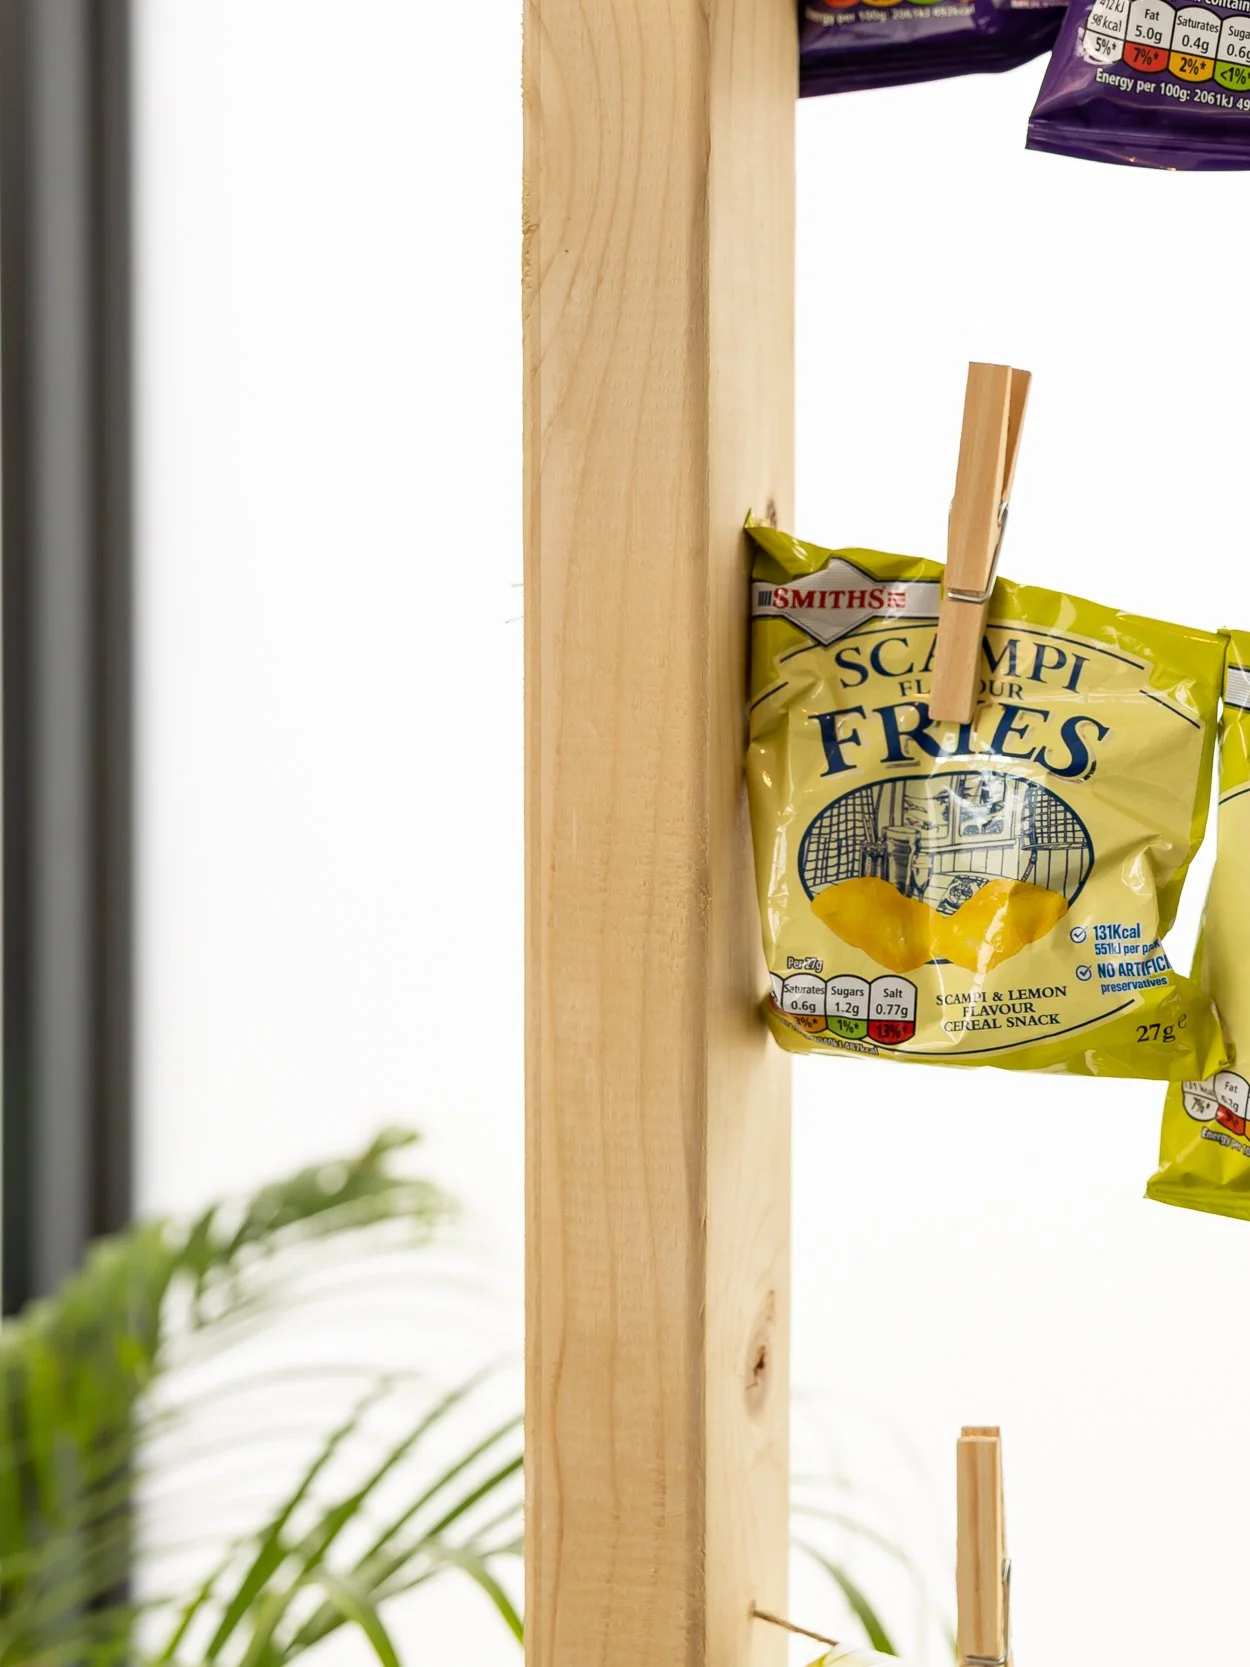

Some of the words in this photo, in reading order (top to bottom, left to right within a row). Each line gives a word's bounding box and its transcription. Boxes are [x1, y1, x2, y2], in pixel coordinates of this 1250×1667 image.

[1103, 14, 1122, 32] kcal
[1144, 8, 1160, 22] Fat
[1177, 15, 1219, 34] Saturates
[1134, 26, 1163, 44] 5.0g
[1181, 34, 1209, 53] 0.4g
[1096, 67, 1134, 92] Energy
[1136, 78, 1156, 94] per
[1160, 83, 1191, 102] 100g:
[1193, 90, 1234, 109] 2061kJ
[772, 587, 884, 611] SMITHS
[808, 700, 1111, 780] FRIES
[1093, 923, 1140, 940] 131Kcal
[1095, 942, 1121, 955] 551kJ
[1123, 944, 1140, 956] per
[787, 957, 802, 970] Per
[802, 957, 824, 973] 27g
[1097, 963, 1115, 978] NO
[783, 984, 825, 995] Saturates
[831, 986, 864, 998] Sugars
[883, 988, 903, 999] Salt
[1101, 977, 1168, 994] preservatives
[936, 990, 988, 1006] SCAMPI
[992, 989, 1003, 1002] &
[1008, 985, 1067, 1001] LEMON
[791, 1000, 816, 1013] 0.6g
[835, 1002, 860, 1016] 1.2g
[875, 1003, 909, 1018] 0.77g
[962, 1002, 1036, 1017] FLAVOUR
[944, 1019, 1002, 1032] CEREAL
[1006, 1013, 1061, 1028] SNACK
[1135, 1022, 1176, 1043] 27g
[1224, 1081, 1238, 1094] Fat
